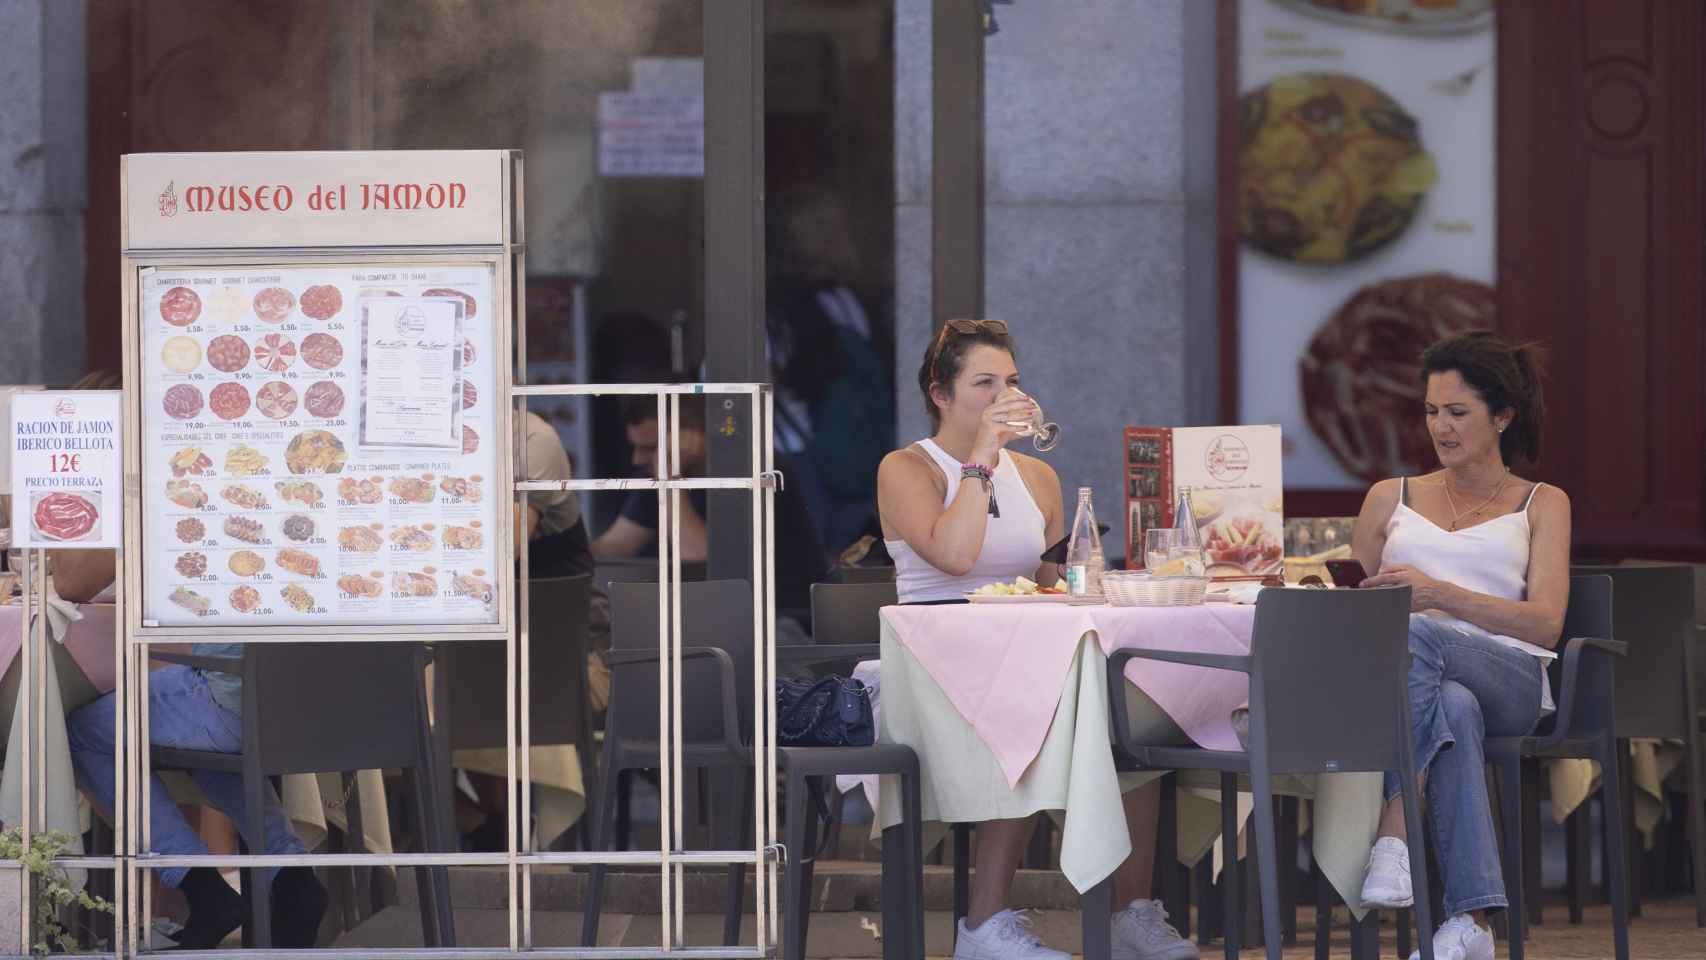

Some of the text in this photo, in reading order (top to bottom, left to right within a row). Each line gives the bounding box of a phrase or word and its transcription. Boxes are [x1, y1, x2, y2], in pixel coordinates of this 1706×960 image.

[185, 185, 293, 212] MUSEO
[307, 184, 345, 211] del
[359, 182, 466, 210] JAMON
[17, 420, 113, 435] RACION DE JAMON
[17, 437, 114, 450] IBERICO BELLOTA
[50, 453, 81, 473] 12€
[25, 476, 103, 487] PRECIO TERRAZA
